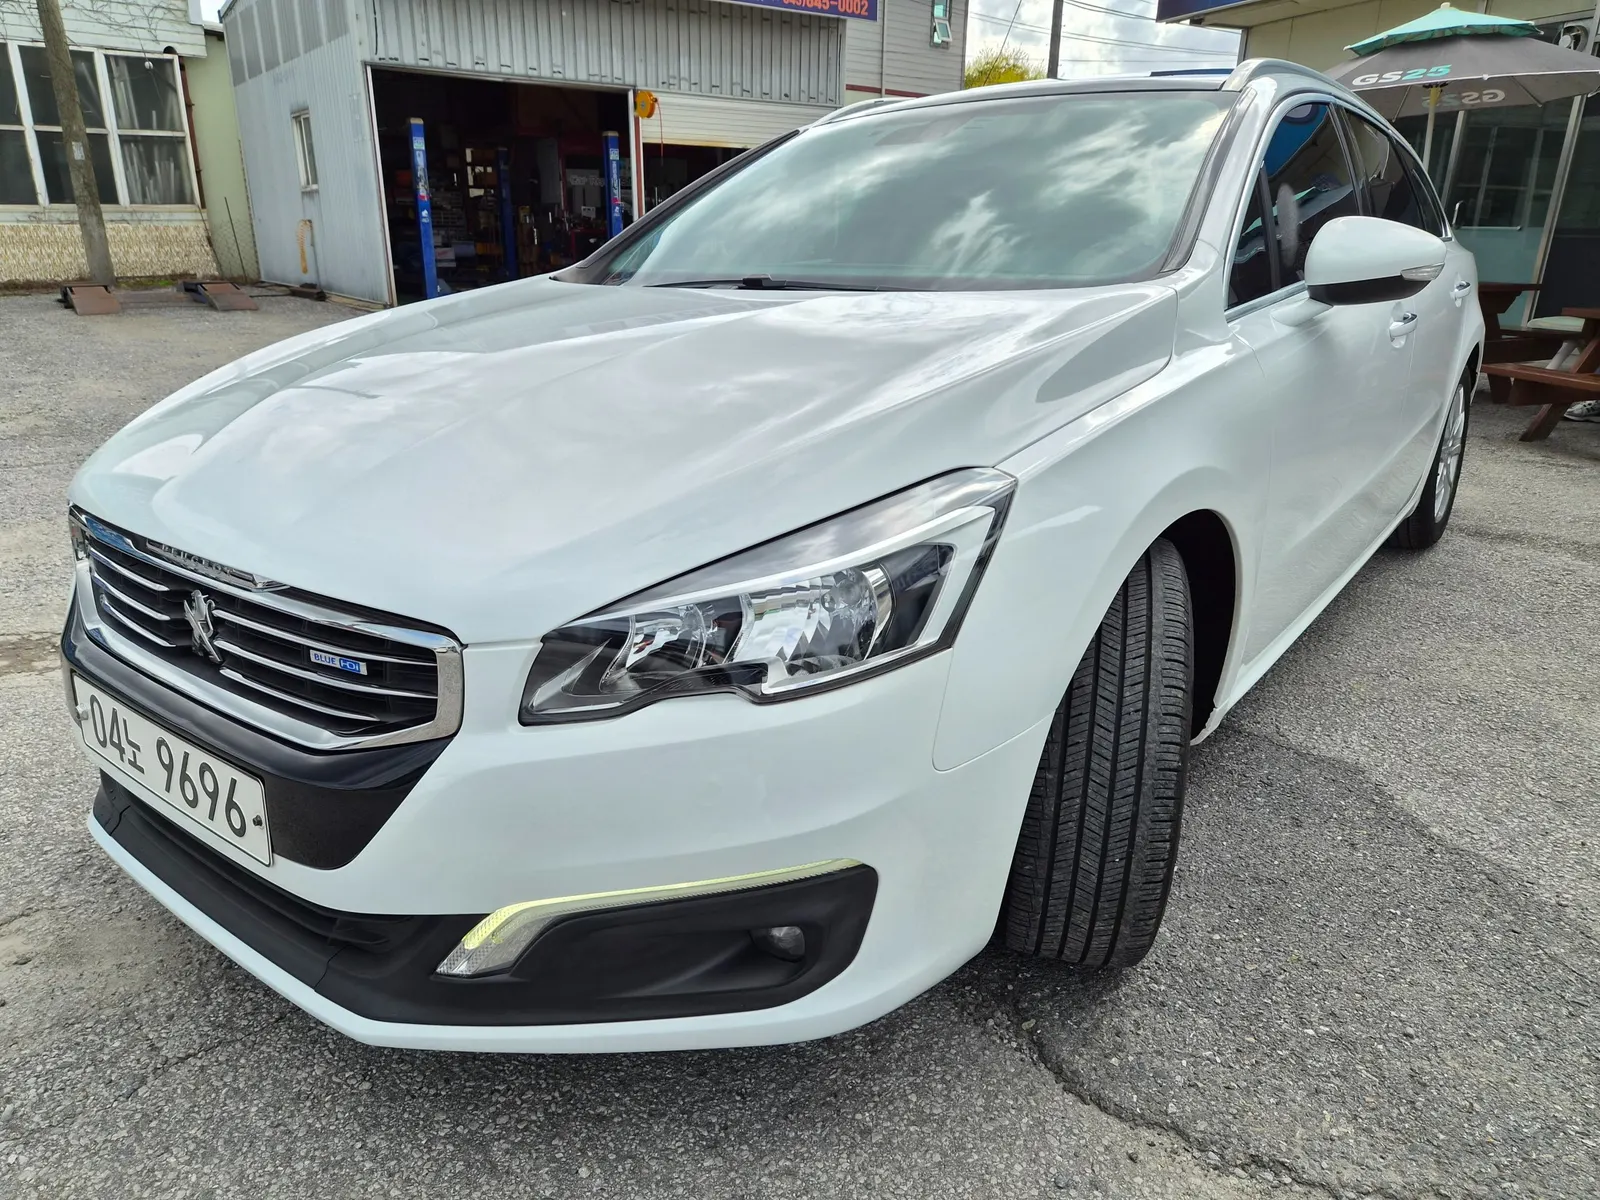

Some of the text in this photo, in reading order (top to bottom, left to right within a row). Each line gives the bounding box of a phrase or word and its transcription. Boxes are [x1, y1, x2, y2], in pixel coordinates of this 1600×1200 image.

[783, 0, 868, 16] )645-0002
[1352, 65, 1452, 86] GS25
[314, 653, 336, 665] BLUE
[90, 694, 247, 838] 04노 9696
